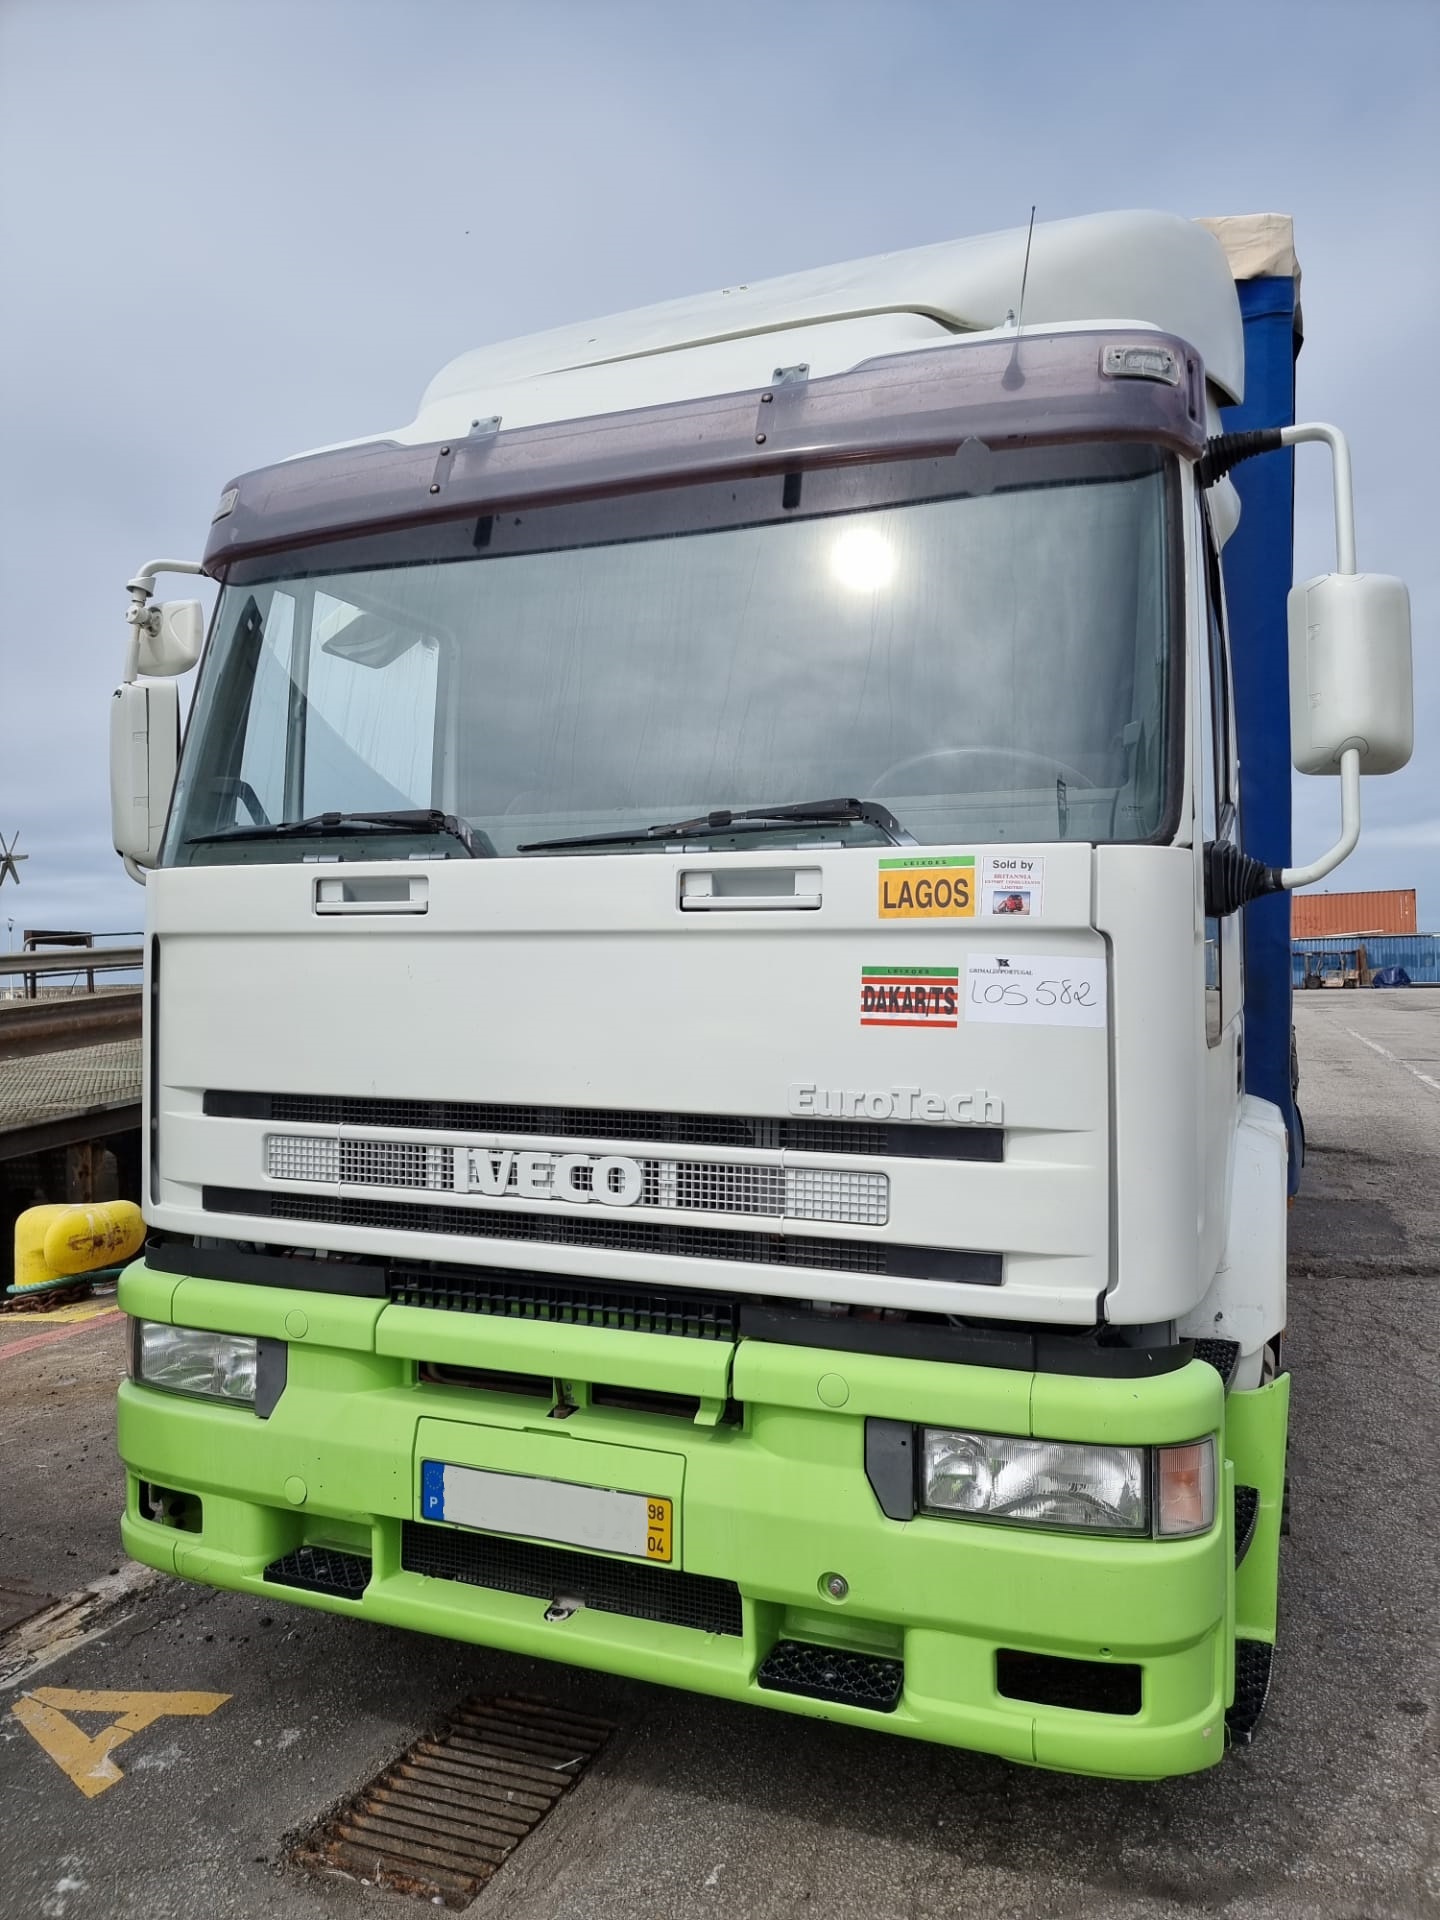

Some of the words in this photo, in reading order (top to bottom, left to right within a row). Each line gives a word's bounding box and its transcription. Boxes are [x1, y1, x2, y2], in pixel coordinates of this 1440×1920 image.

[992, 859, 1017, 869] Sold
[1020, 860, 1034, 871] by
[883, 878, 969, 909] LAGOS
[863, 985, 956, 1017] DAKAR/TS
[971, 979, 1029, 1006] LOS
[1035, 979, 1097, 1007] 582
[788, 1083, 1004, 1125] EuroTech
[453, 1146, 642, 1206] IVECO
[429, 1496, 438, 1509] P
[647, 1504, 665, 1522] 98
[647, 1535, 665, 1554] 04
